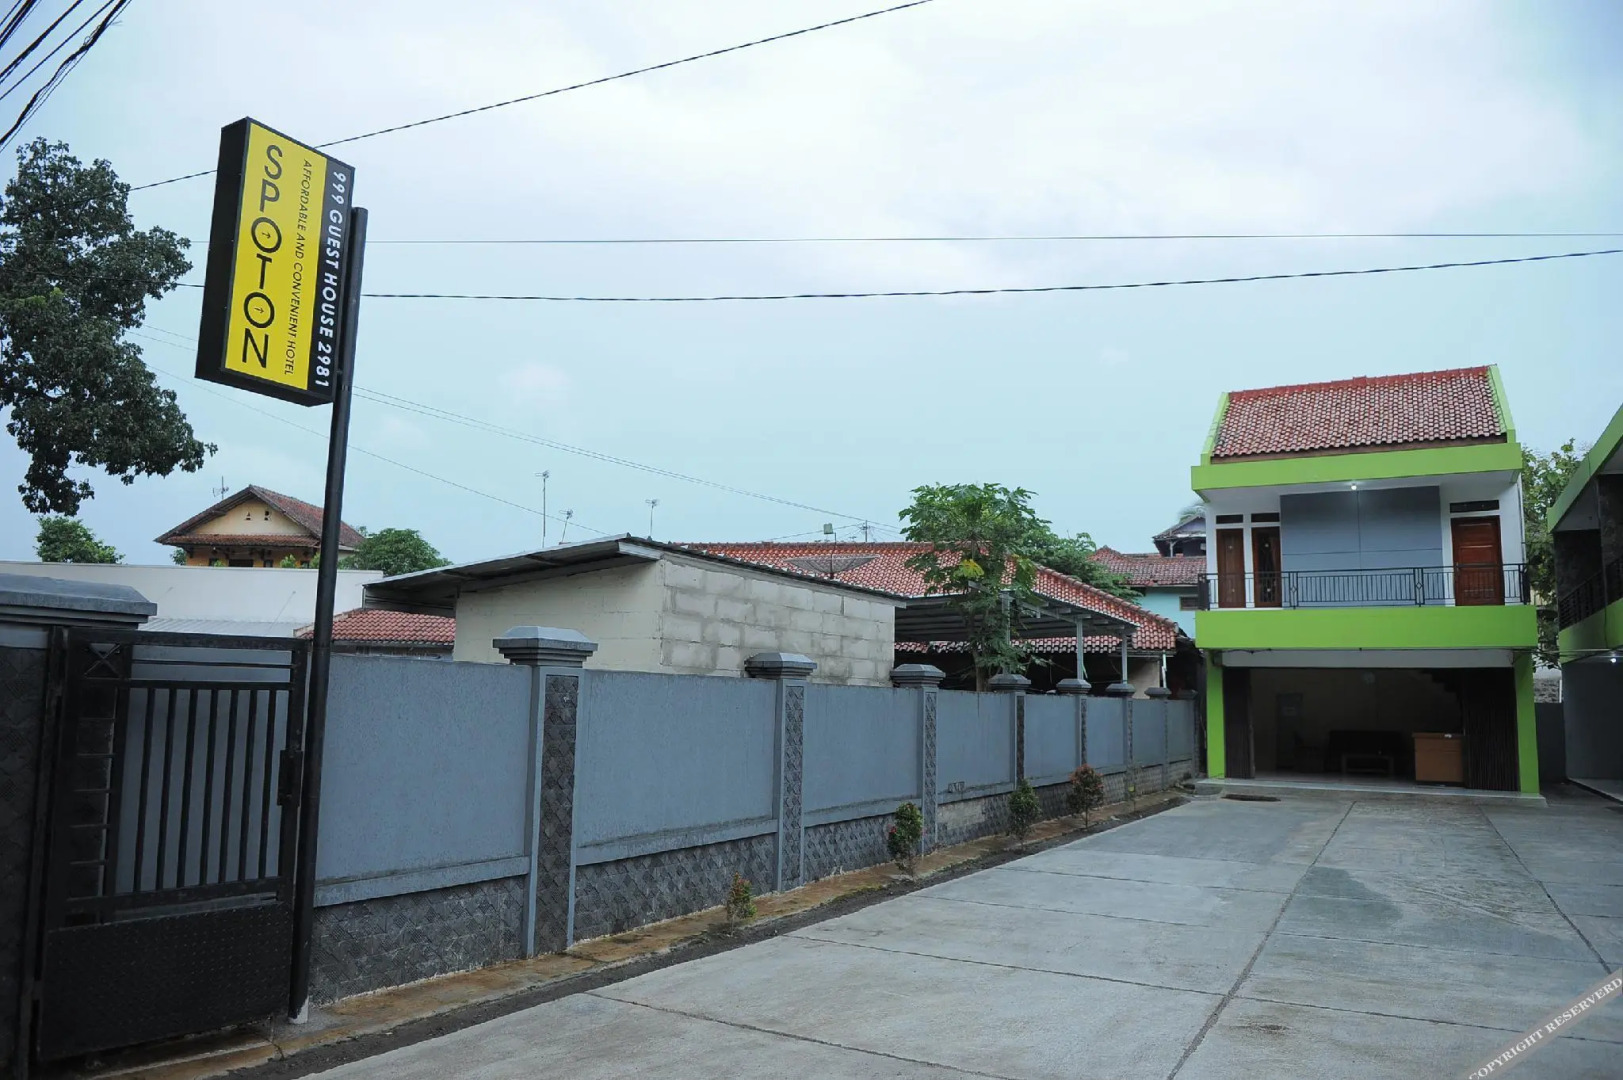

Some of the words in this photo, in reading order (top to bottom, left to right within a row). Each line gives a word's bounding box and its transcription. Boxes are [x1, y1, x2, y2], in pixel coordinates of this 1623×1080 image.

[297, 158, 312, 231] AFFORDABLE
[331, 171, 347, 205] 999
[295, 232, 306, 259] AND
[325, 209, 343, 270] GUEST
[287, 262, 303, 338] CONVENIENT
[319, 272, 338, 338] HOUSE
[284, 340, 296, 375] HOTEL
[315, 341, 332, 387] 2981
